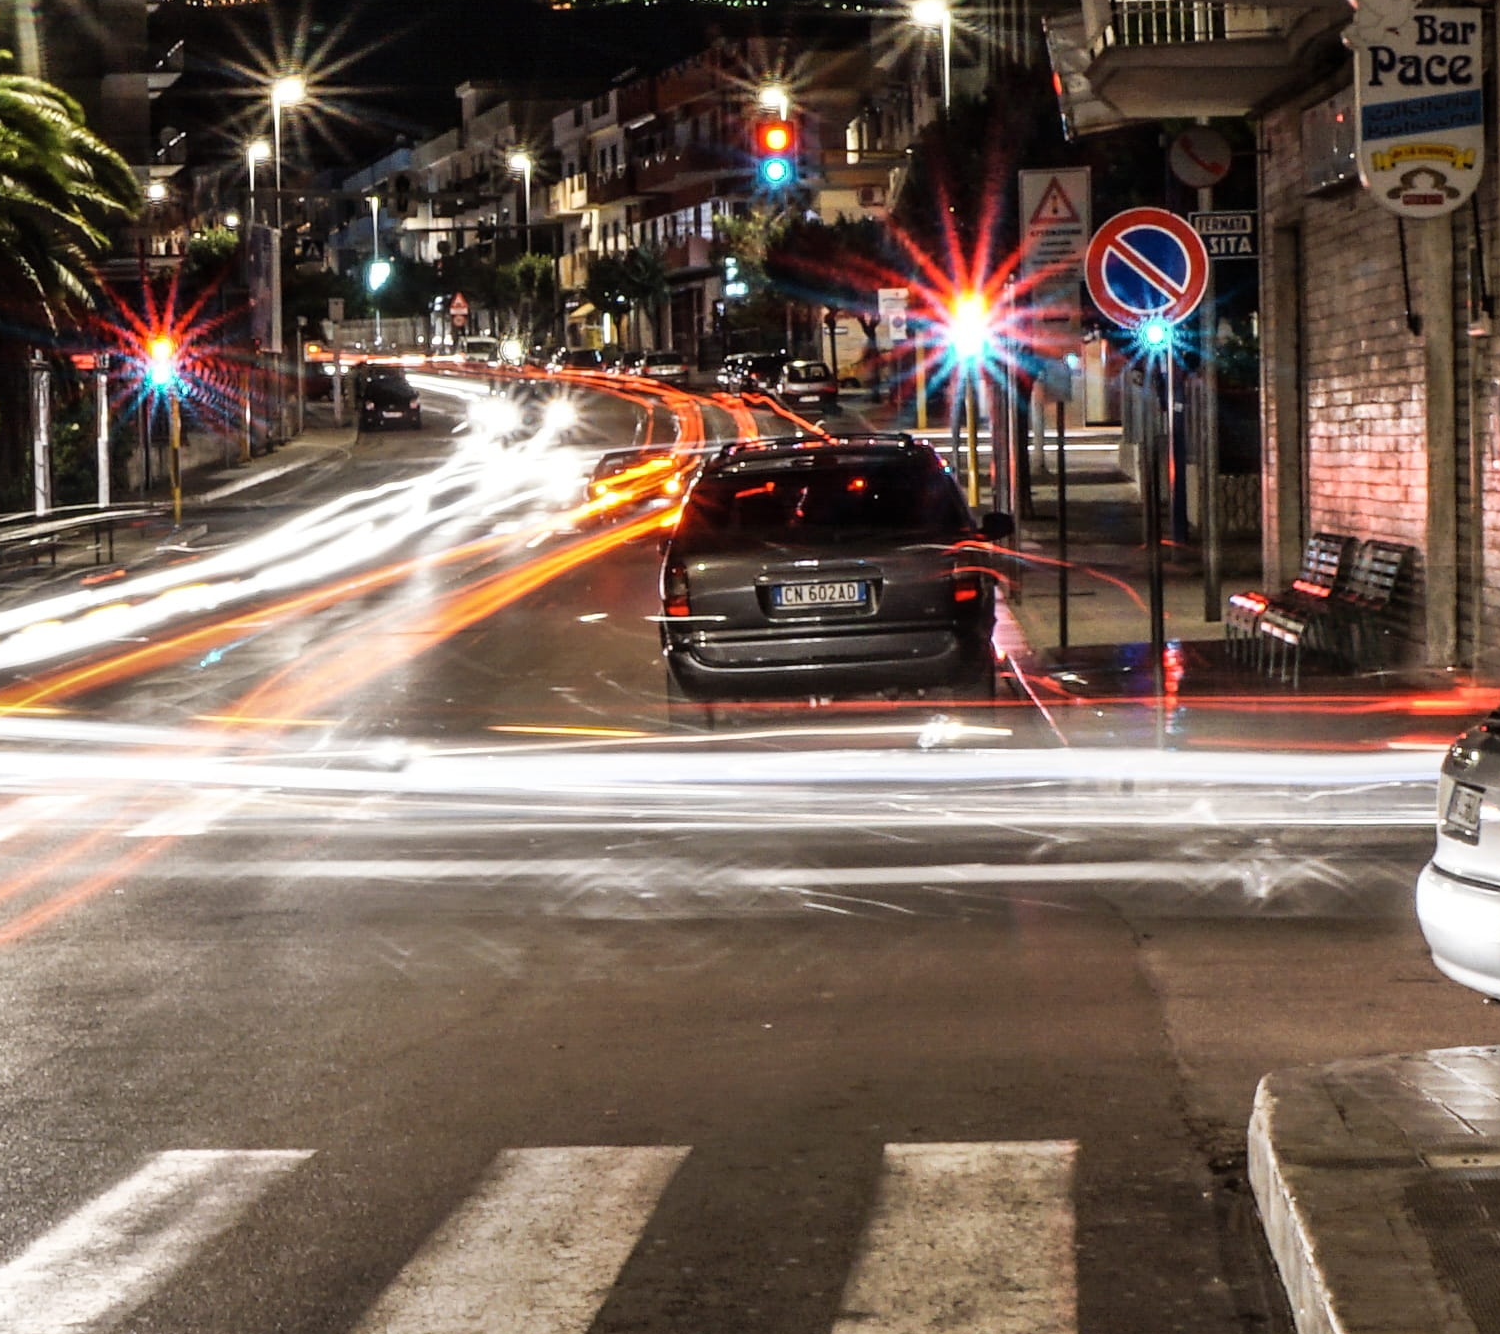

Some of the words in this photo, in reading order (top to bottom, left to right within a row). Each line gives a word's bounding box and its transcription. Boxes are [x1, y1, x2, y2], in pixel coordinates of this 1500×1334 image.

[1413, 15, 1476, 45] Bar
[1367, 45, 1473, 86] Pace
[1210, 236, 1252, 254] SITA
[785, 587, 803, 603] CN
[808, 584, 856, 601] 602AD
